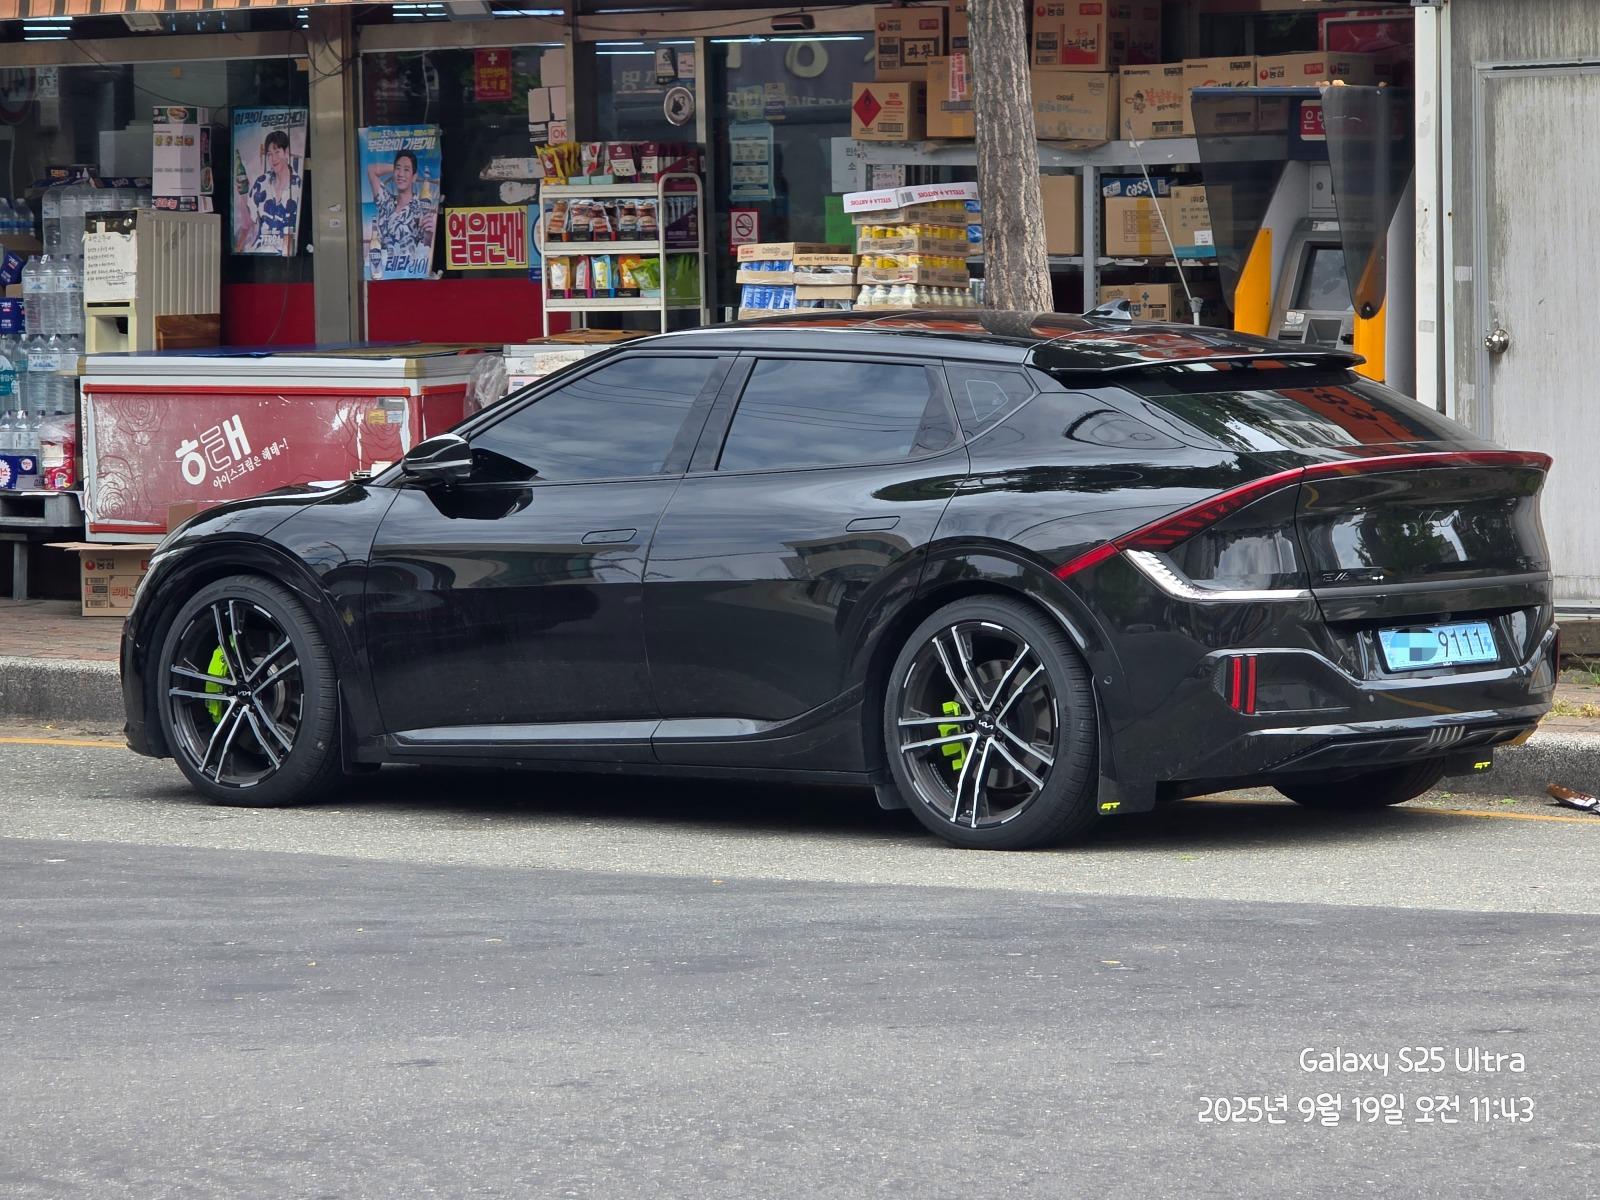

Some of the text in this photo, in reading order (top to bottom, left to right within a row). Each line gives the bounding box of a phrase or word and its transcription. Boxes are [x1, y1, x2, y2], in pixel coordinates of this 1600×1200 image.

[448, 212, 526, 265] 얼음판매
[213, 455, 262, 489] 아이스크림은
[1438, 627, 1485, 658] 9111
